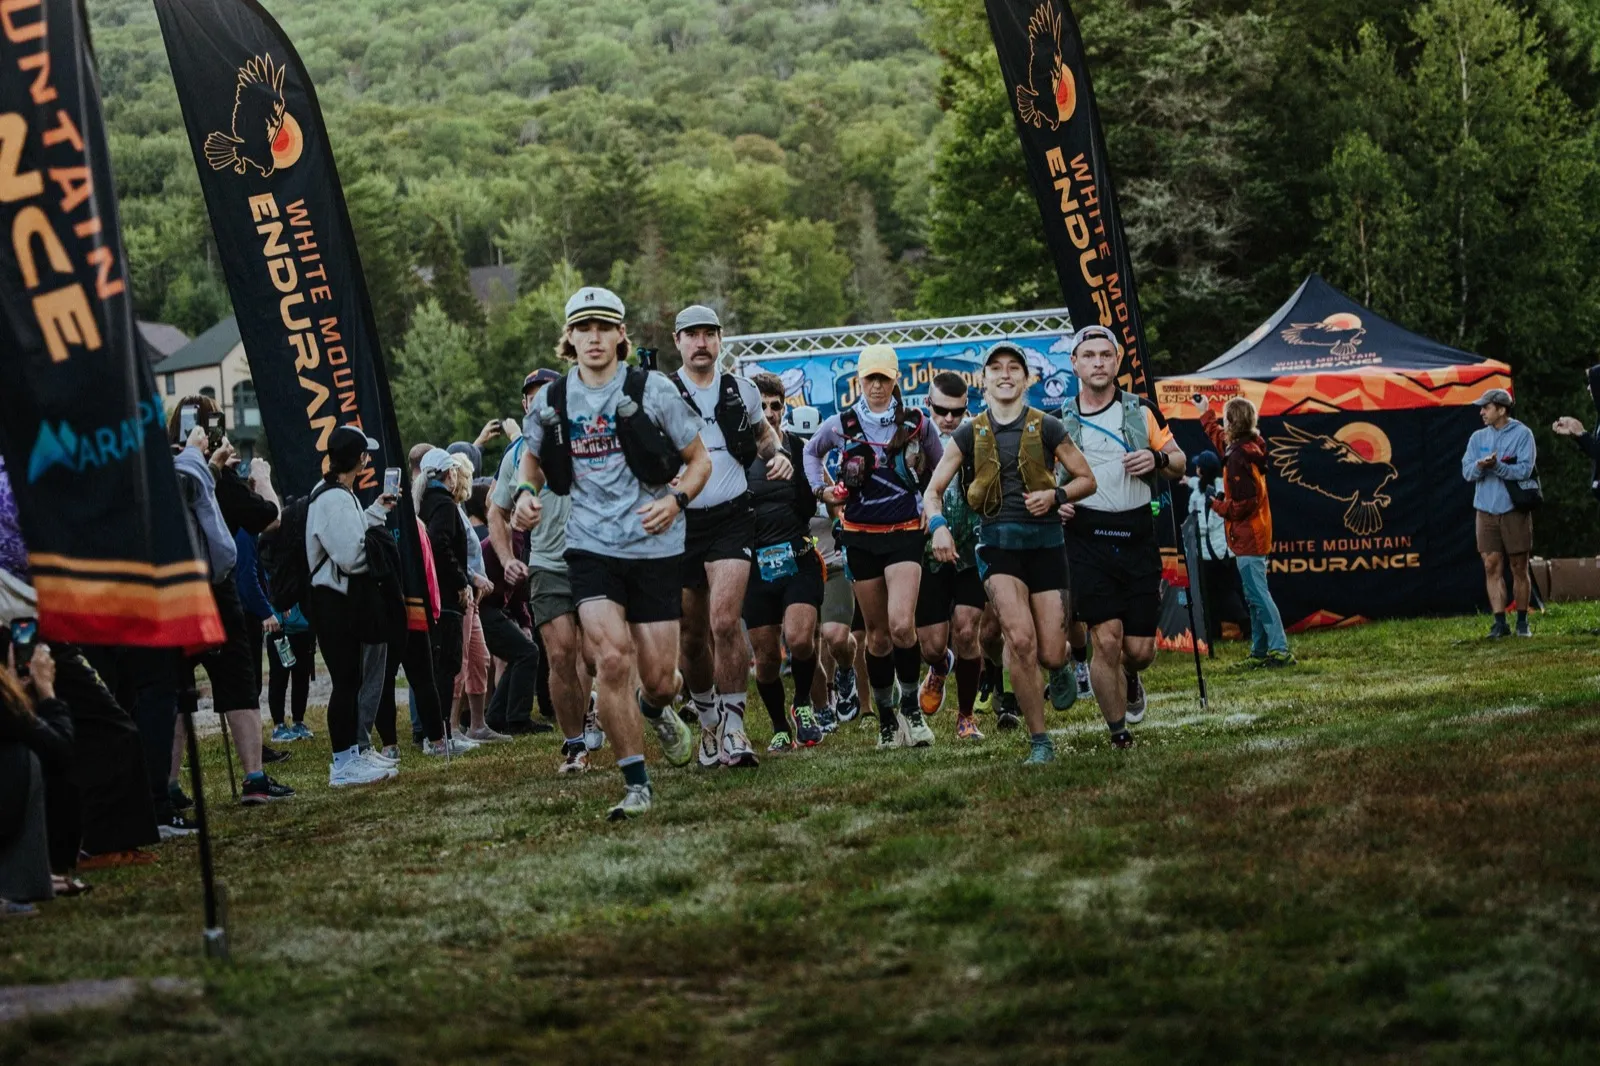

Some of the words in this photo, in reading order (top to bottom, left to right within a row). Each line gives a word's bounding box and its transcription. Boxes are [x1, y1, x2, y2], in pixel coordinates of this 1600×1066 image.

[0, 0, 126, 299] UNTAIN
[248, 191, 338, 475] ENDURAN
[1069, 152, 1111, 260] WHITE
[1105, 272, 1149, 398] MOUNT
[284, 198, 332, 304] WHITE
[318, 316, 379, 490] MOUNTN
[769, 558, 784, 570] 15
[1094, 529, 1131, 538] SALOMON
[1265, 552, 1420, 574] NDURANCE
[1323, 535, 1412, 552] MOUNTAIN
